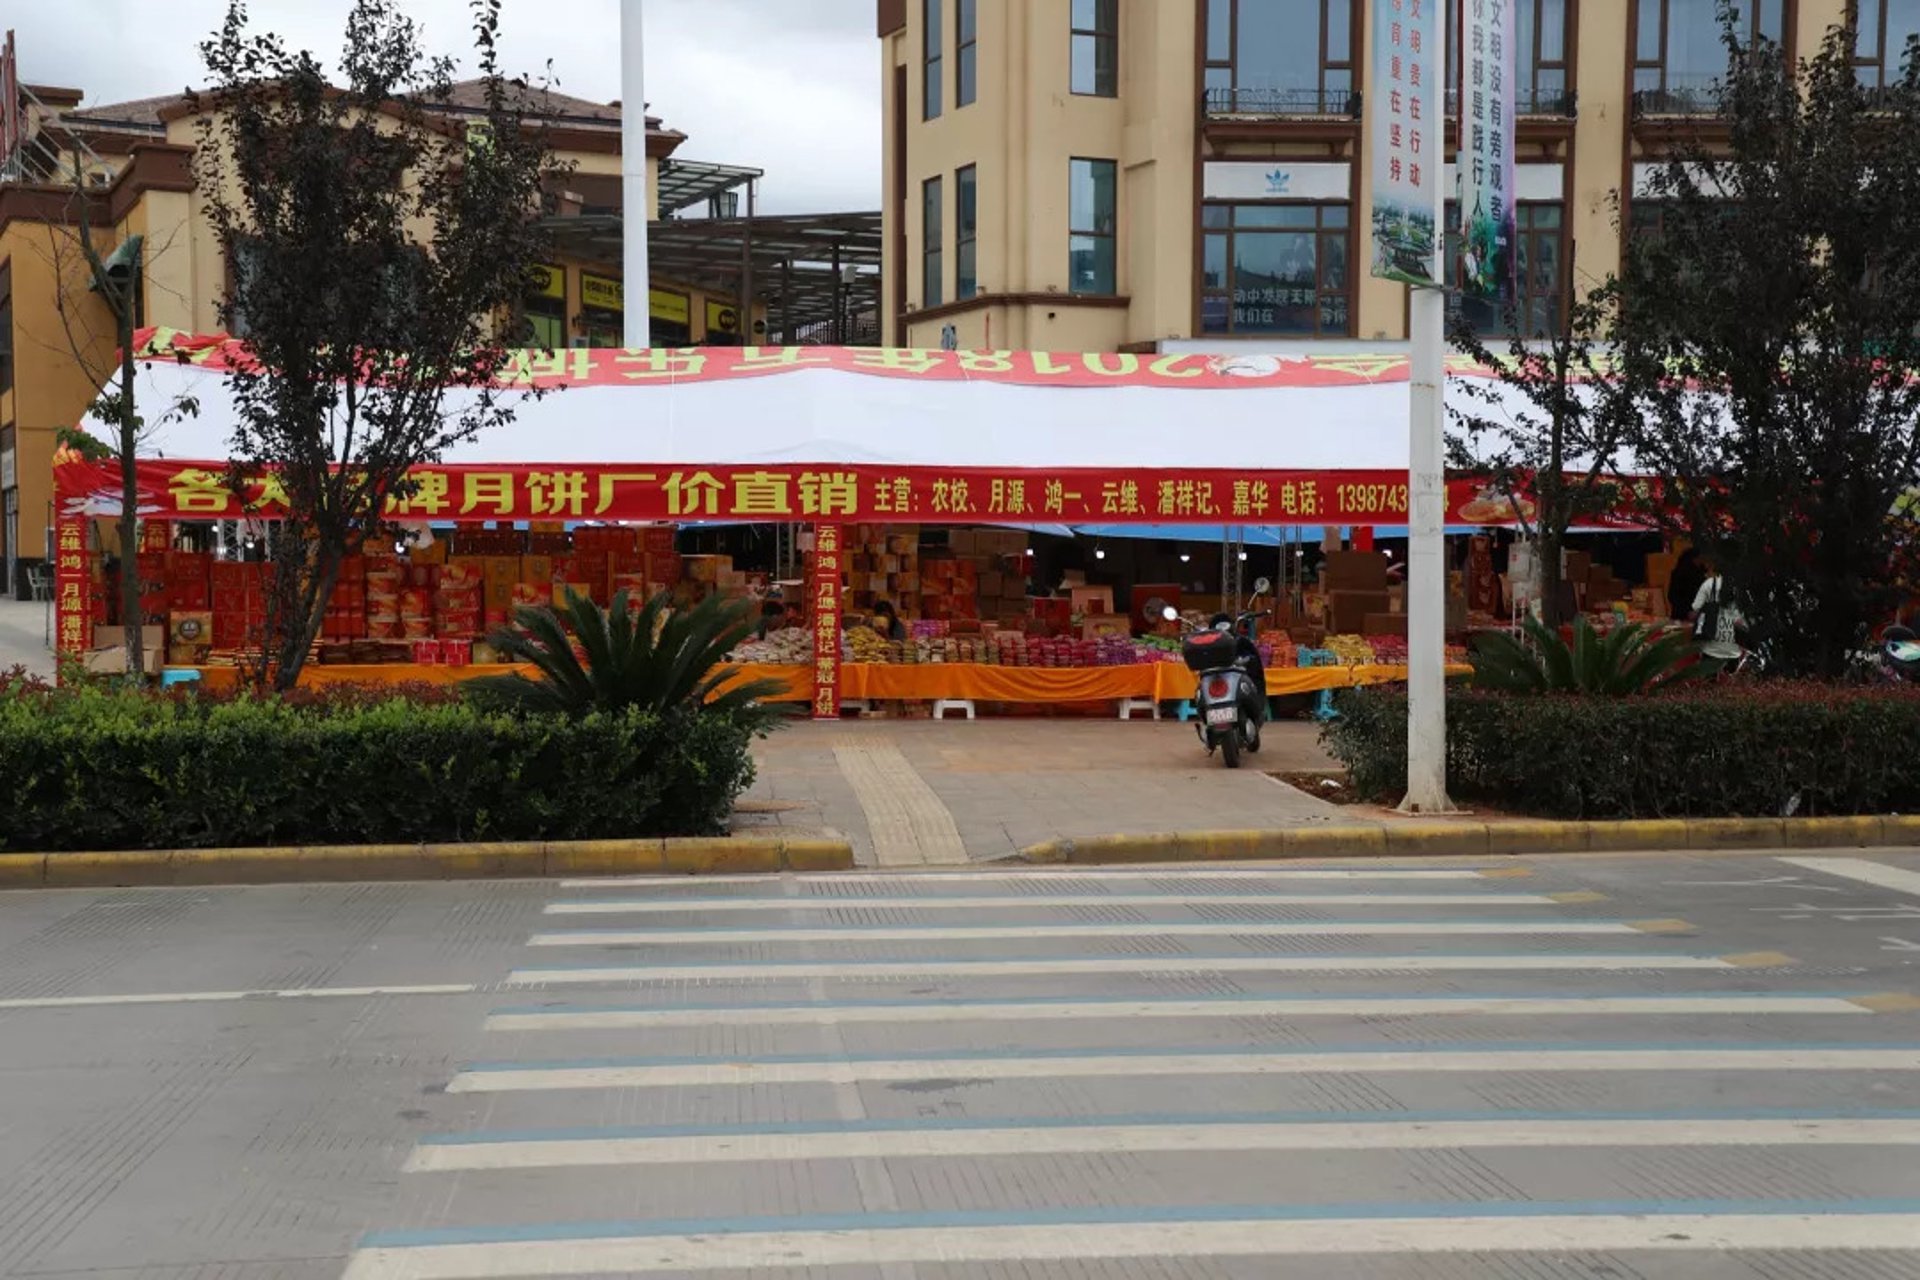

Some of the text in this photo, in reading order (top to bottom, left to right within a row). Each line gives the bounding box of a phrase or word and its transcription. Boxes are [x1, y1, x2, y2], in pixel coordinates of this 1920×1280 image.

[168, 470, 858, 515] 各大牌月饼厂价直销
